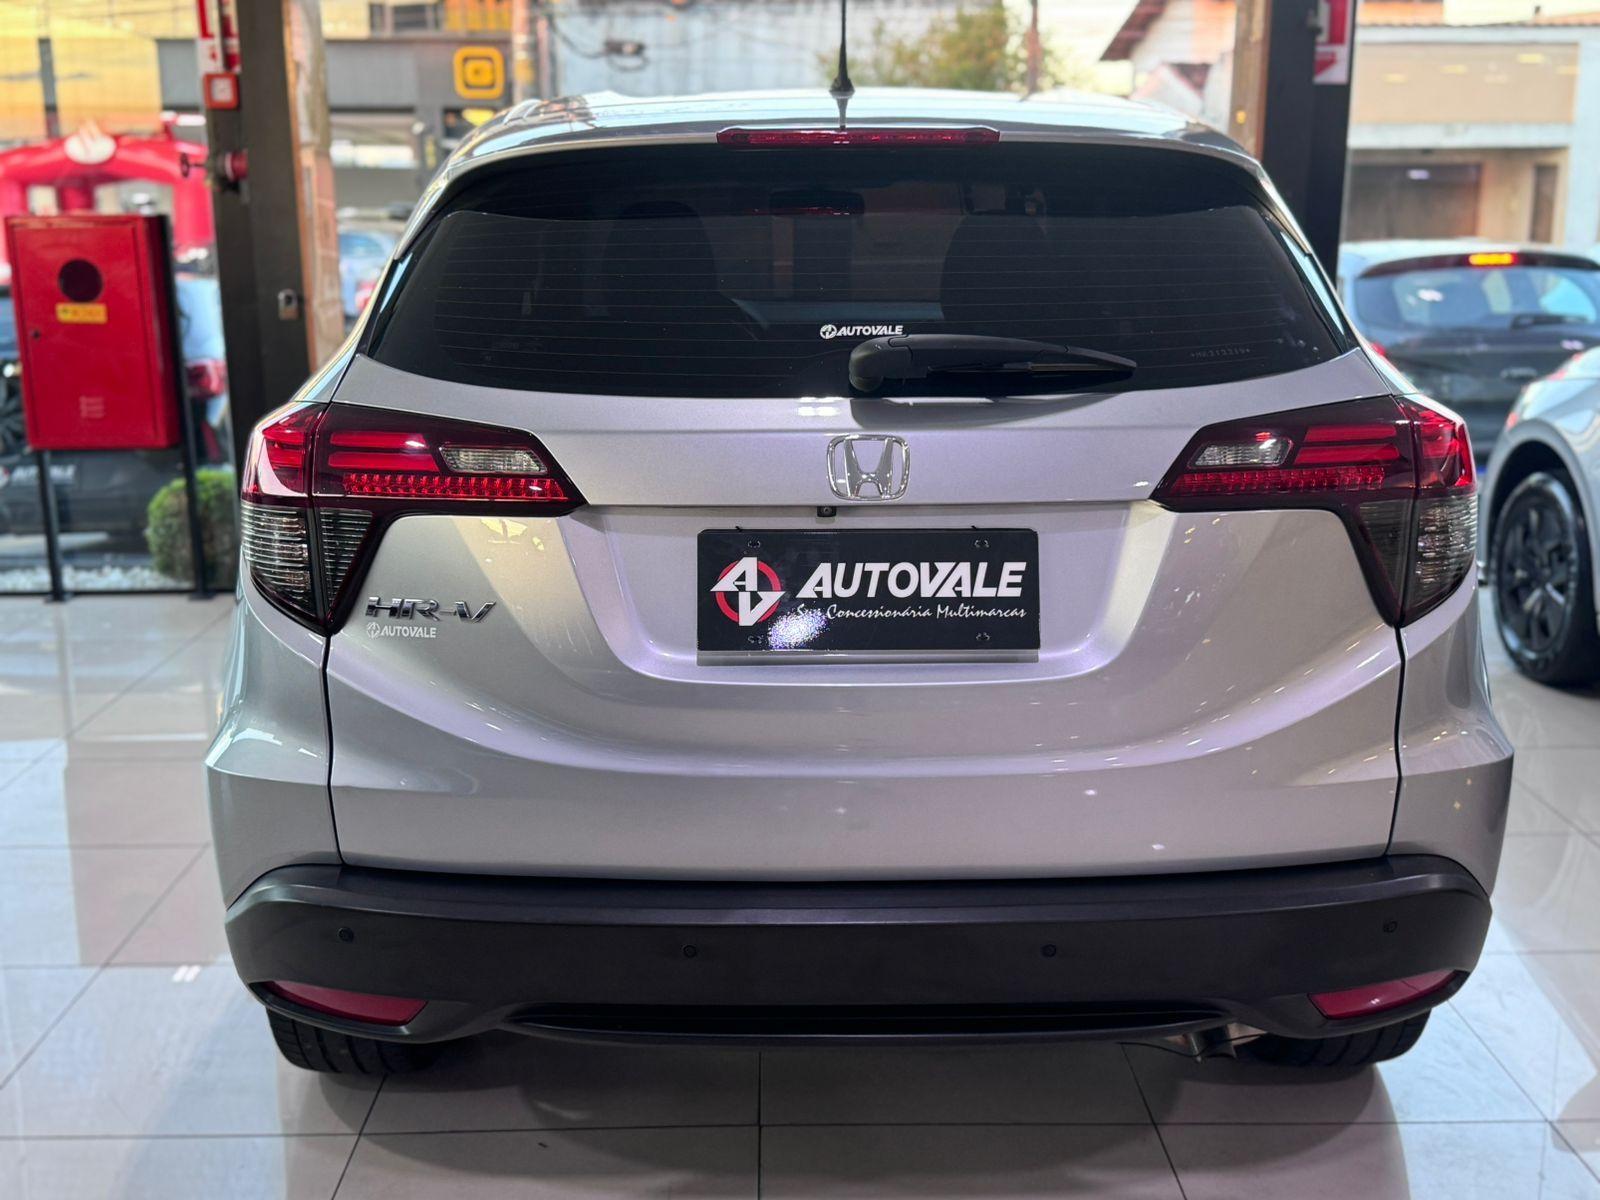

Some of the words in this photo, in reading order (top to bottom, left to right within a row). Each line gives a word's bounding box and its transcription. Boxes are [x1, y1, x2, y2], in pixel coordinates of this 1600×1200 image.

[836, 325, 904, 336] AUTOVALE
[795, 561, 1027, 599] AUTOVALE
[365, 596, 497, 624] HR-V
[826, 603, 932, 620] Concessionária
[936, 602, 1028, 619] Multimarcas
[380, 625, 437, 639] AUTOVALE
